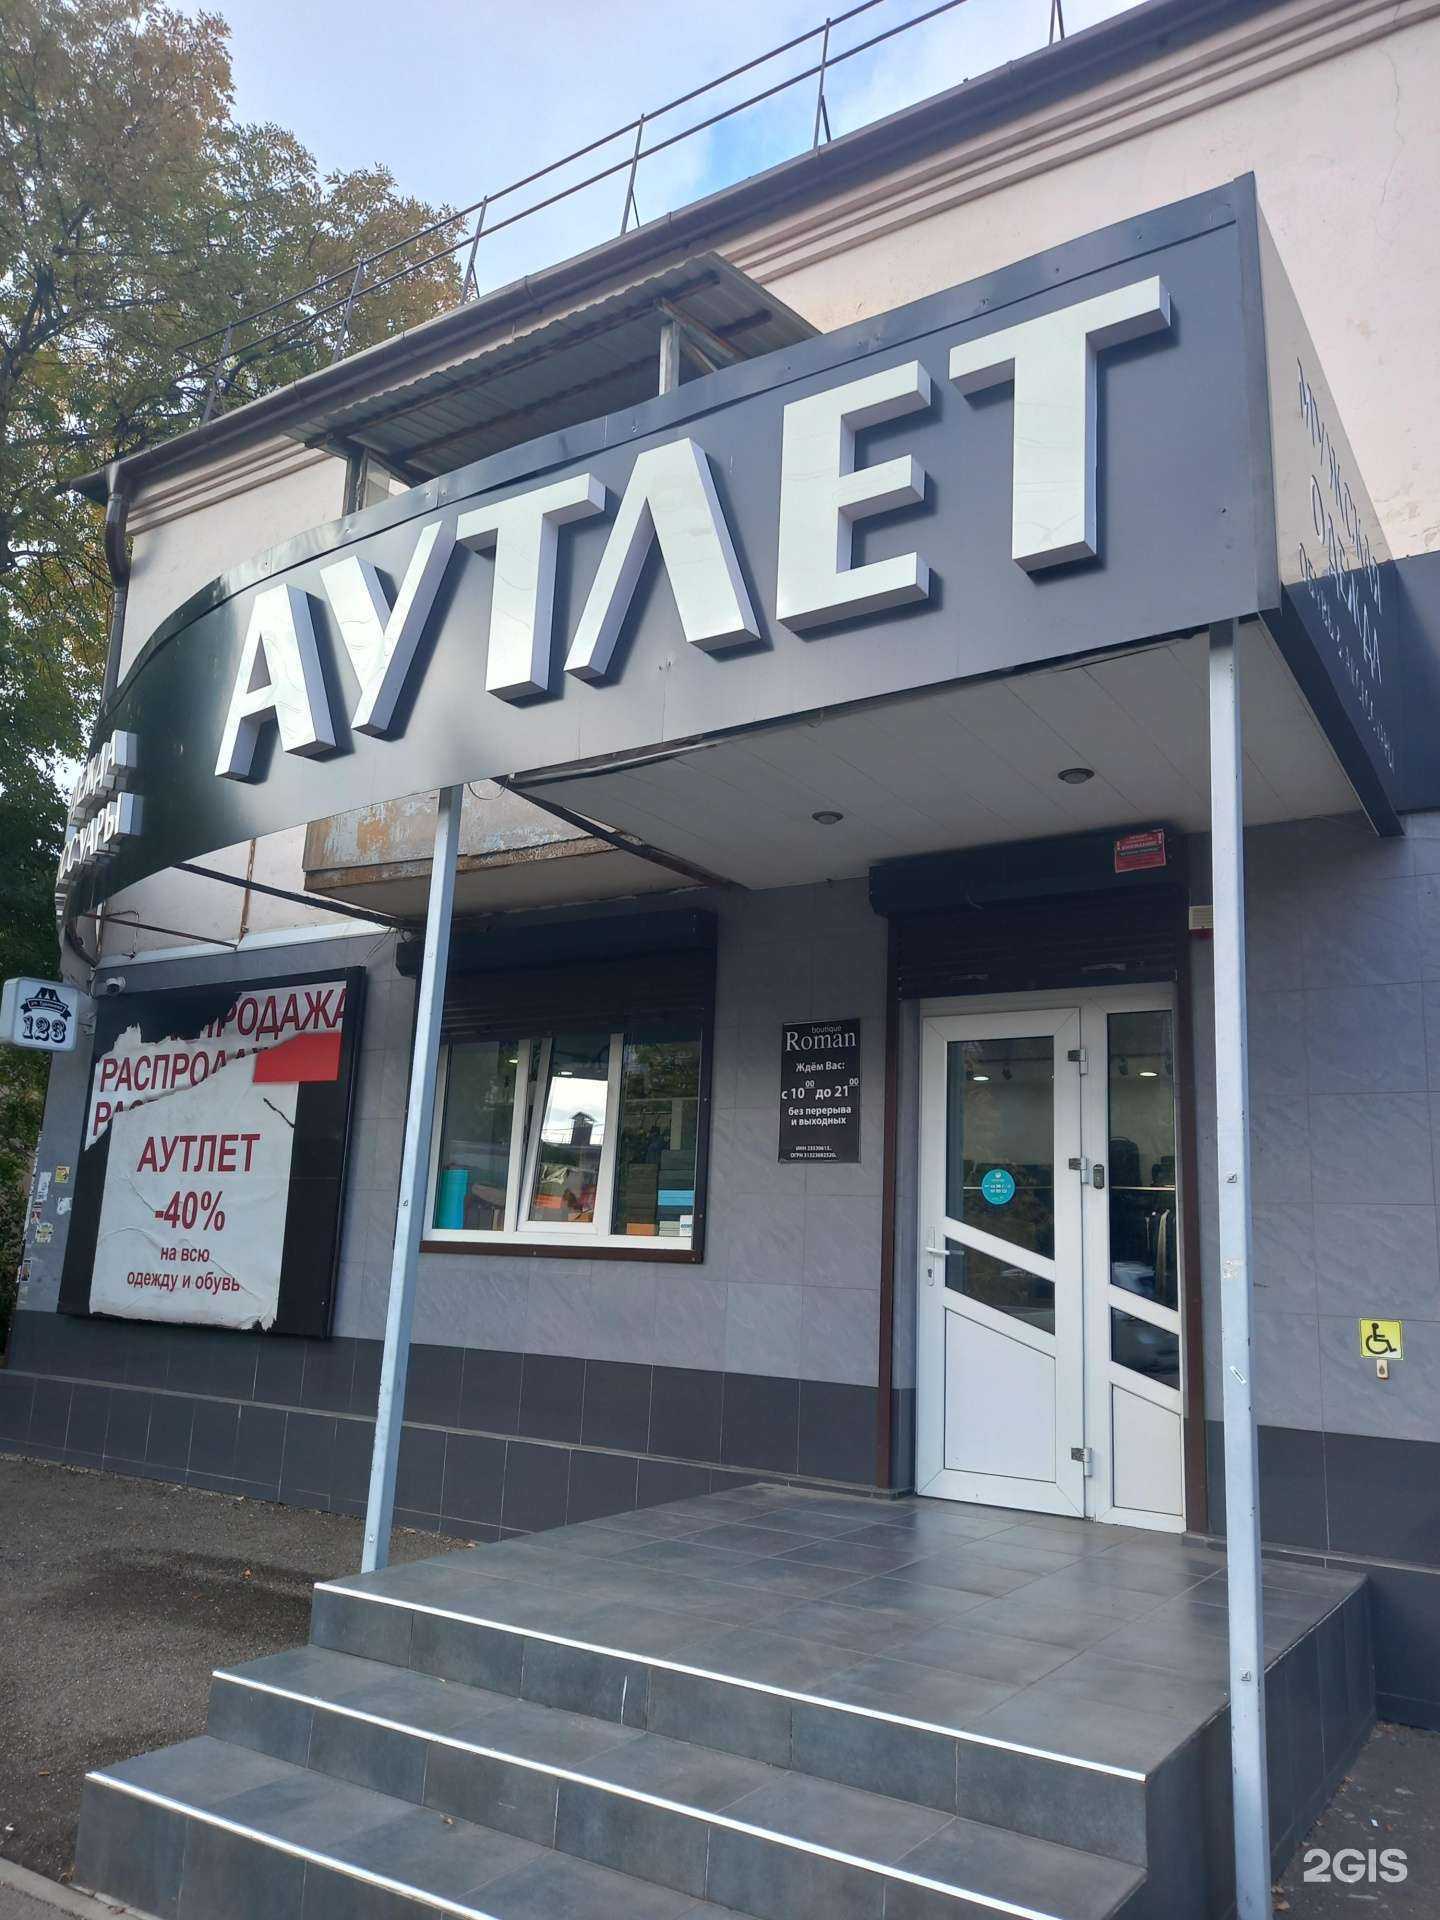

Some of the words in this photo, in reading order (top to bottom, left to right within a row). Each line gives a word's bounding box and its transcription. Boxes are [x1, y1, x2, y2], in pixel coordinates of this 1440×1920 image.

[215, 275, 1171, 781] АУТЛЕТ
[23, 1015, 67, 1043] 123
[785, 1032, 857, 1051] Roman
[795, 1062, 824, 1073] Ждём
[825, 1061, 845, 1071] Вас:
[781, 1090, 788, 1099] с
[815, 1088, 831, 1100] до
[788, 1106, 804, 1116] без
[805, 1105, 852, 1117] перерыва
[791, 1118, 798, 1126] и
[799, 1116, 847, 1127] выходных
[136, 1133, 261, 1173] АУТЛЕТ
[155, 1190, 226, 1231] -40%
[160, 1247, 177, 1261] на
[181, 1247, 210, 1263] всю
[127, 1271, 178, 1292] одежду
[182, 1275, 191, 1288] и
[195, 1271, 241, 1296] обувь
